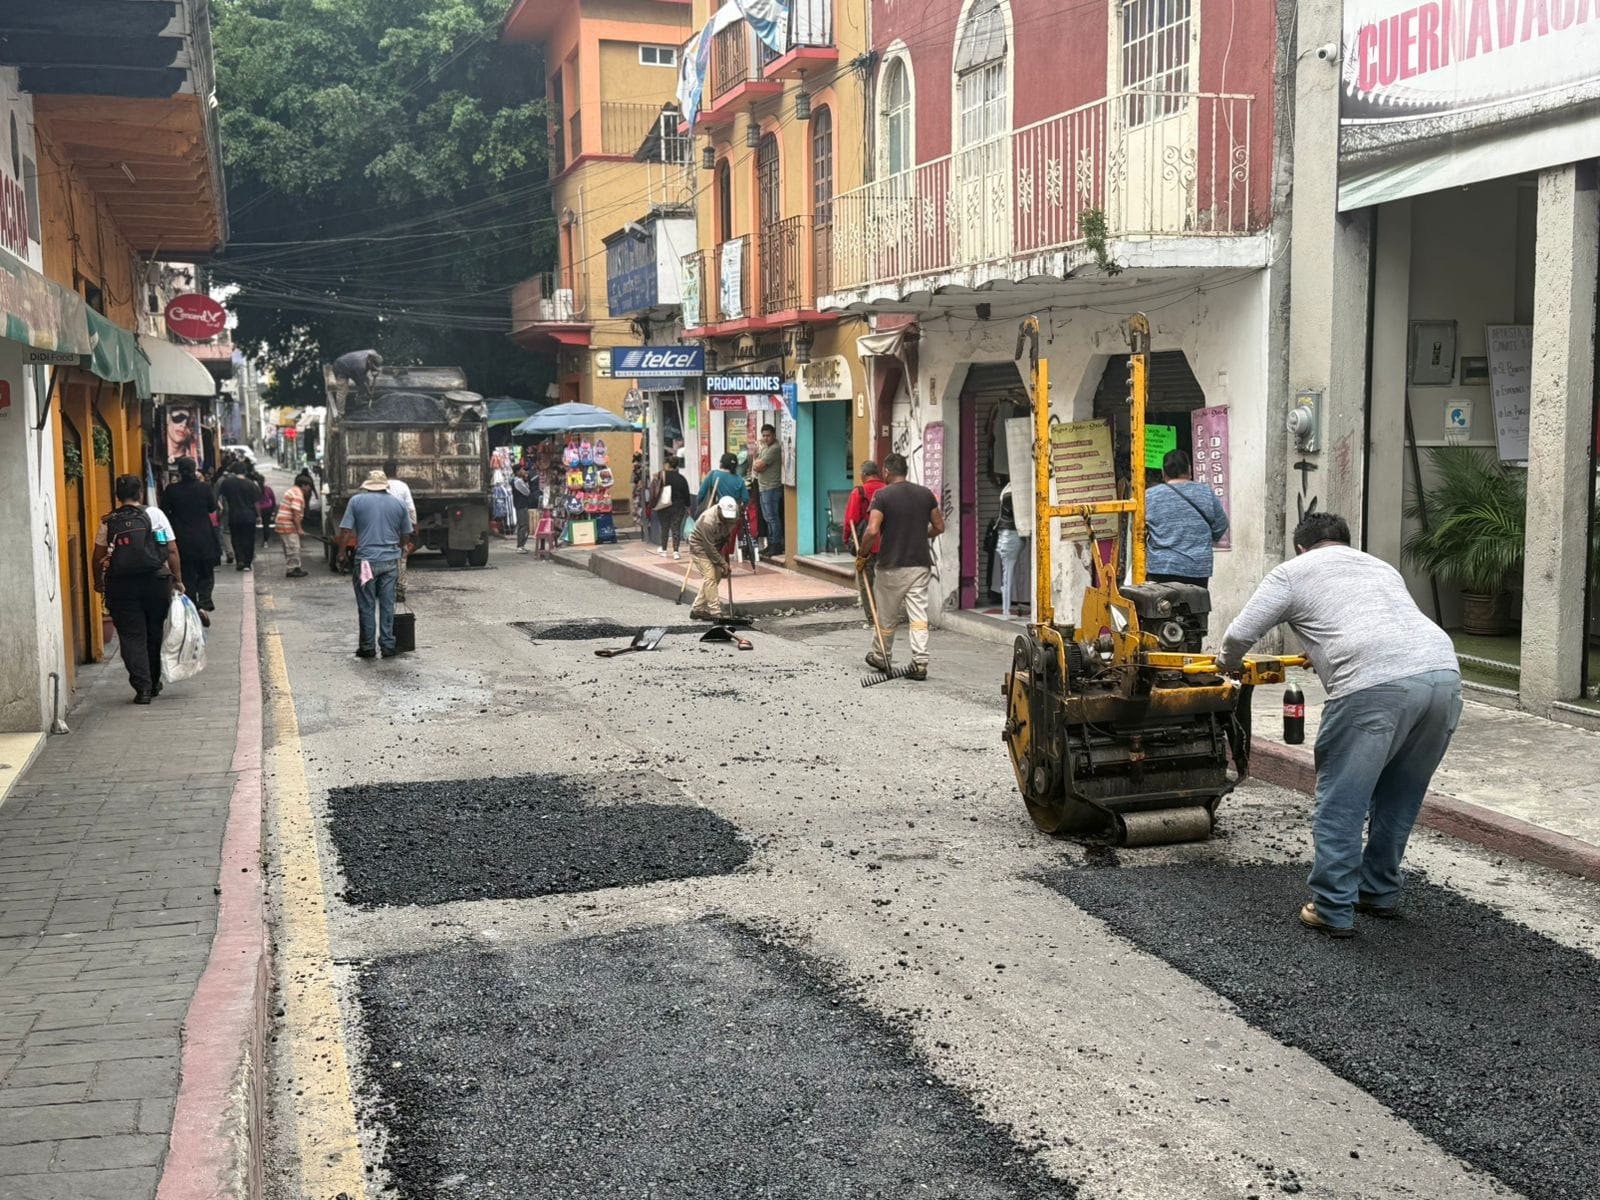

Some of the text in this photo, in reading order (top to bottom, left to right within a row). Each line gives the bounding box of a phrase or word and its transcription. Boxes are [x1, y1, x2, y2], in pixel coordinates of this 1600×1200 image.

[51, 352, 74, 361] Food
[641, 350, 698, 368] telcel
[707, 376, 780, 391] PROMOCIONES
